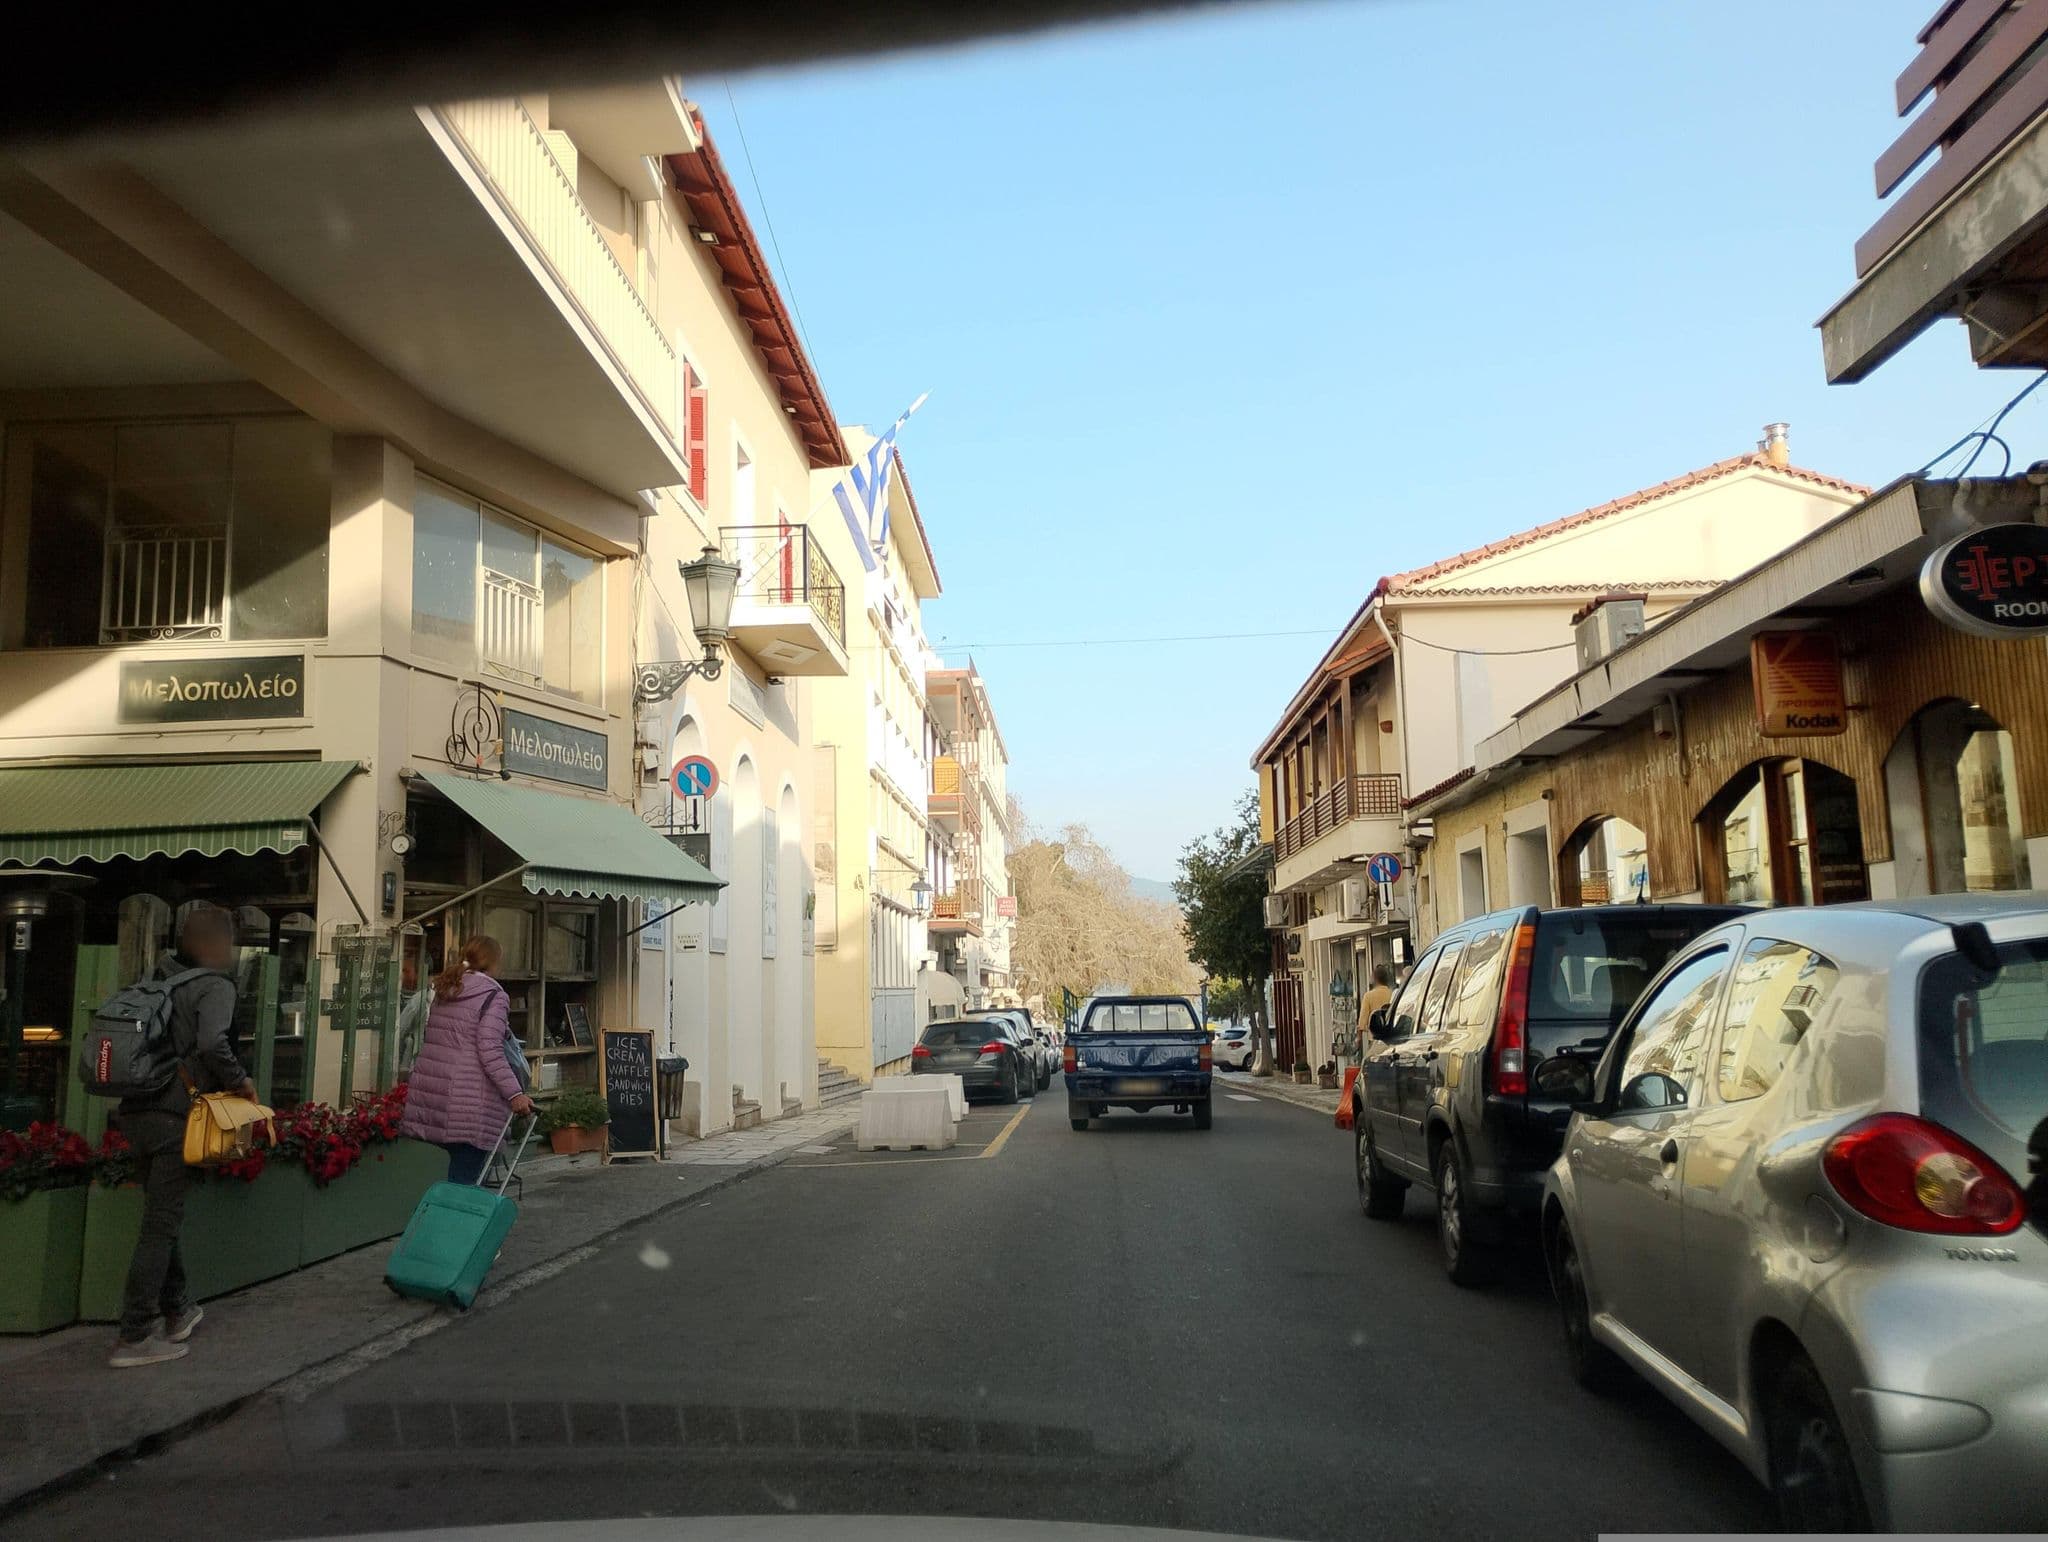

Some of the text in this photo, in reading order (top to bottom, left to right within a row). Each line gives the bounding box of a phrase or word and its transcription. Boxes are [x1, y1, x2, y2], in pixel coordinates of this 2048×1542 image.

[128, 673, 298, 702] Μελοπωλείο
[1786, 712, 1840, 728] Kodak
[510, 727, 603, 771] Μελοπωλείο
[616, 1036, 638, 1050] ICE
[100, 1040, 111, 1082] Supreme
[607, 1047, 645, 1065] CREAM
[608, 1064, 651, 1077] WAFFLE
[607, 1077, 651, 1094] SANDWICH
[620, 1091, 643, 1105] PIES
